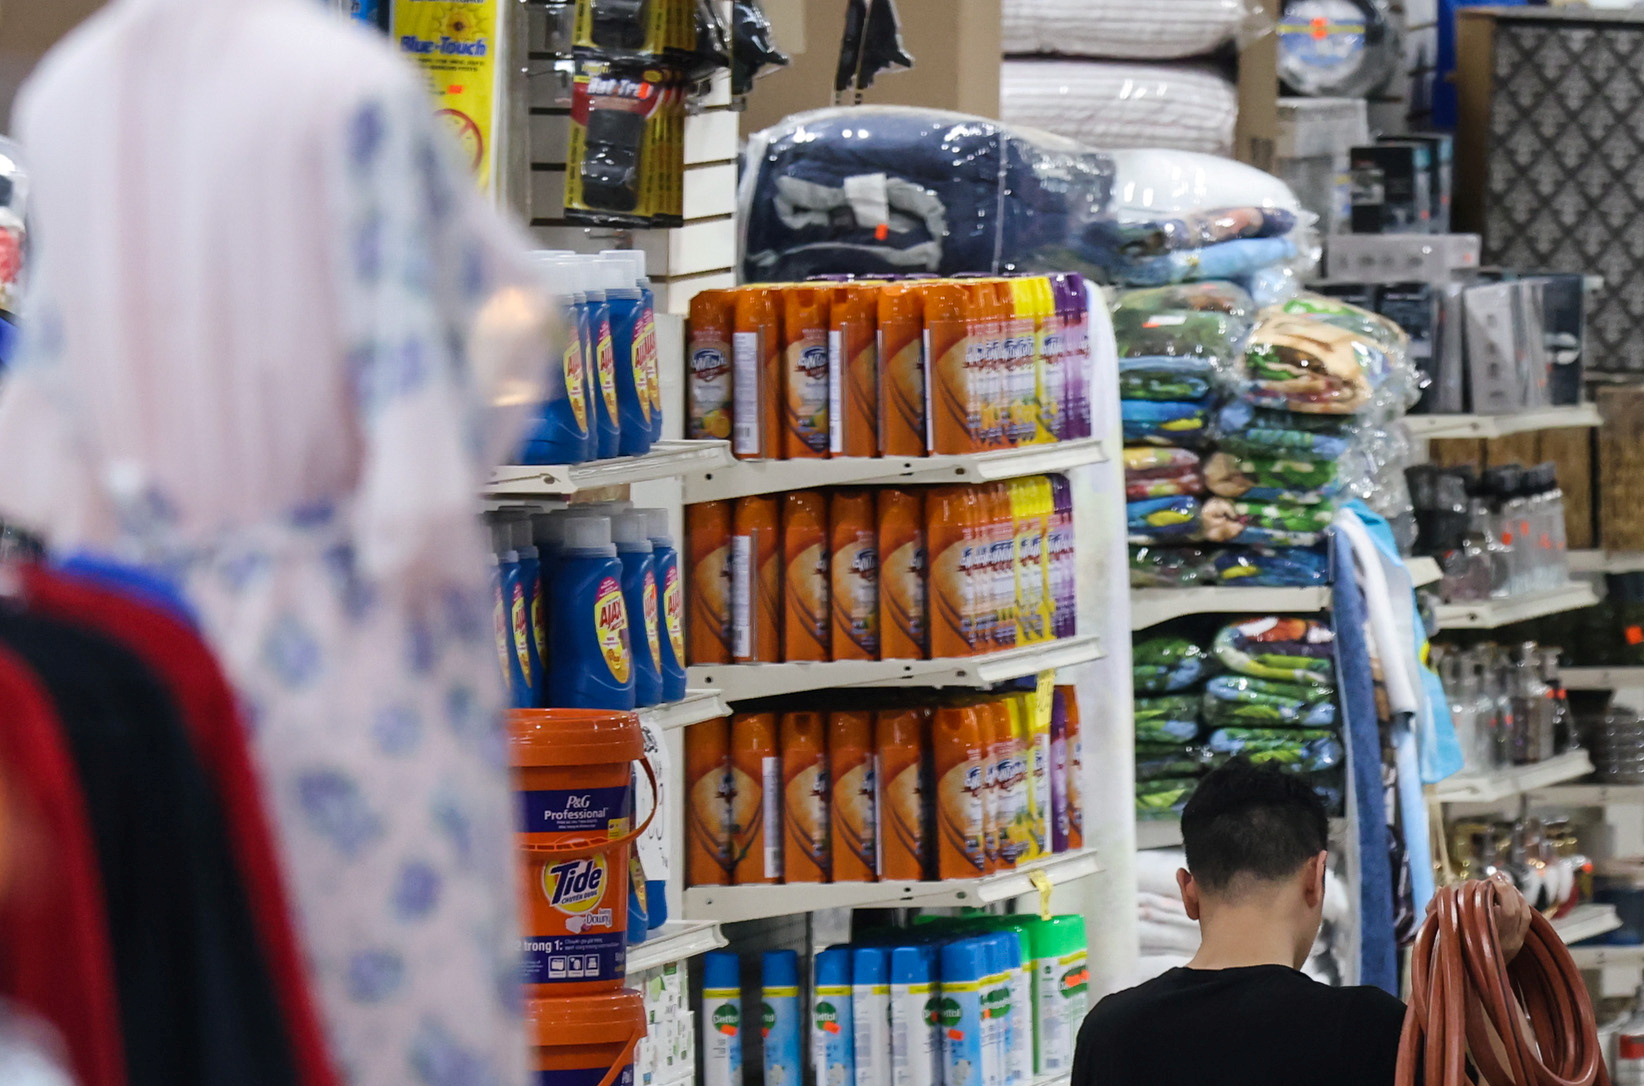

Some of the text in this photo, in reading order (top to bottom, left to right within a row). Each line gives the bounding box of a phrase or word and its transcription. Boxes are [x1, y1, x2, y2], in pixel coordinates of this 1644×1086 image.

[600, 600, 622, 628] AJAX
[566, 795, 591, 809] P&G
[544, 808, 606, 821] Professional
[550, 860, 602, 905] Tide
[586, 913, 611, 926] Downy
[524, 941, 552, 953] trong
[554, 940, 563, 951] 1:
[713, 1013, 738, 1023] Dettol
